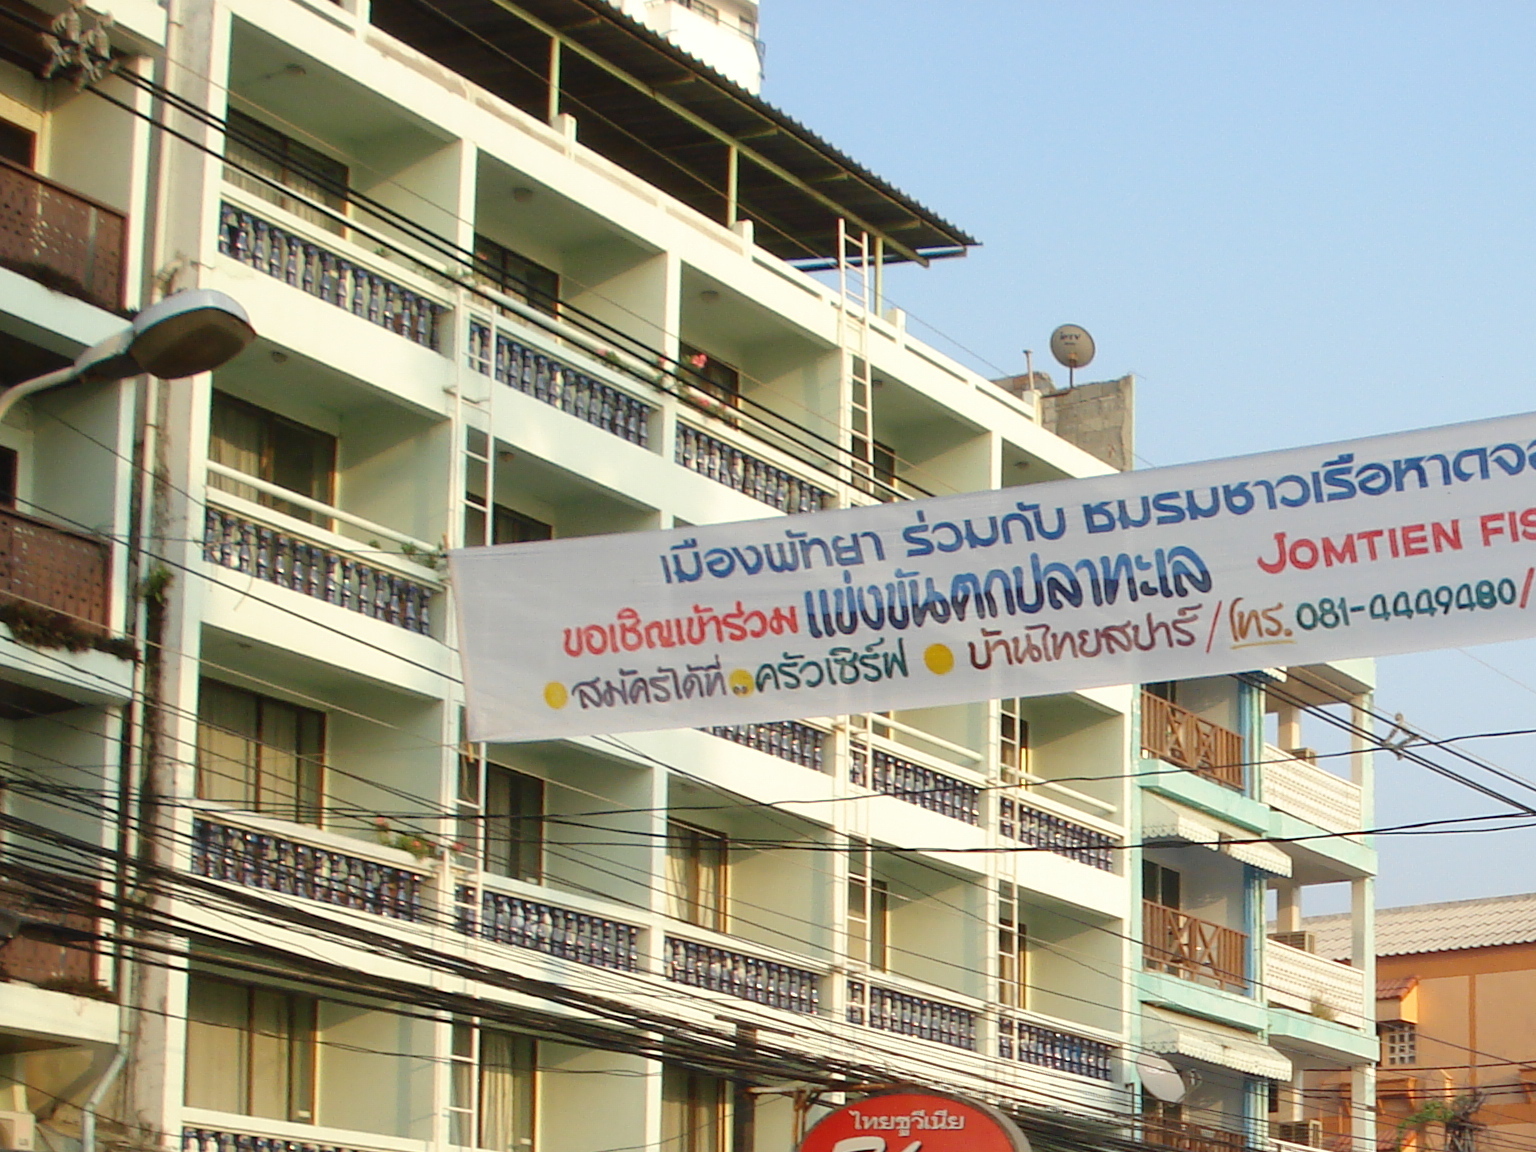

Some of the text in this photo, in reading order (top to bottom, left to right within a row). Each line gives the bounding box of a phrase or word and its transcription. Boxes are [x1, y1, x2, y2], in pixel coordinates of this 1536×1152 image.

[661, 529, 887, 584] เมืองพัทยา
[902, 501, 1067, 557] ร่วมกับ
[1257, 518, 1462, 575] JOMTIEN
[563, 545, 1213, 657] ขอเชิญเข้าร่วม แข่งขันตกปลาทะเล
